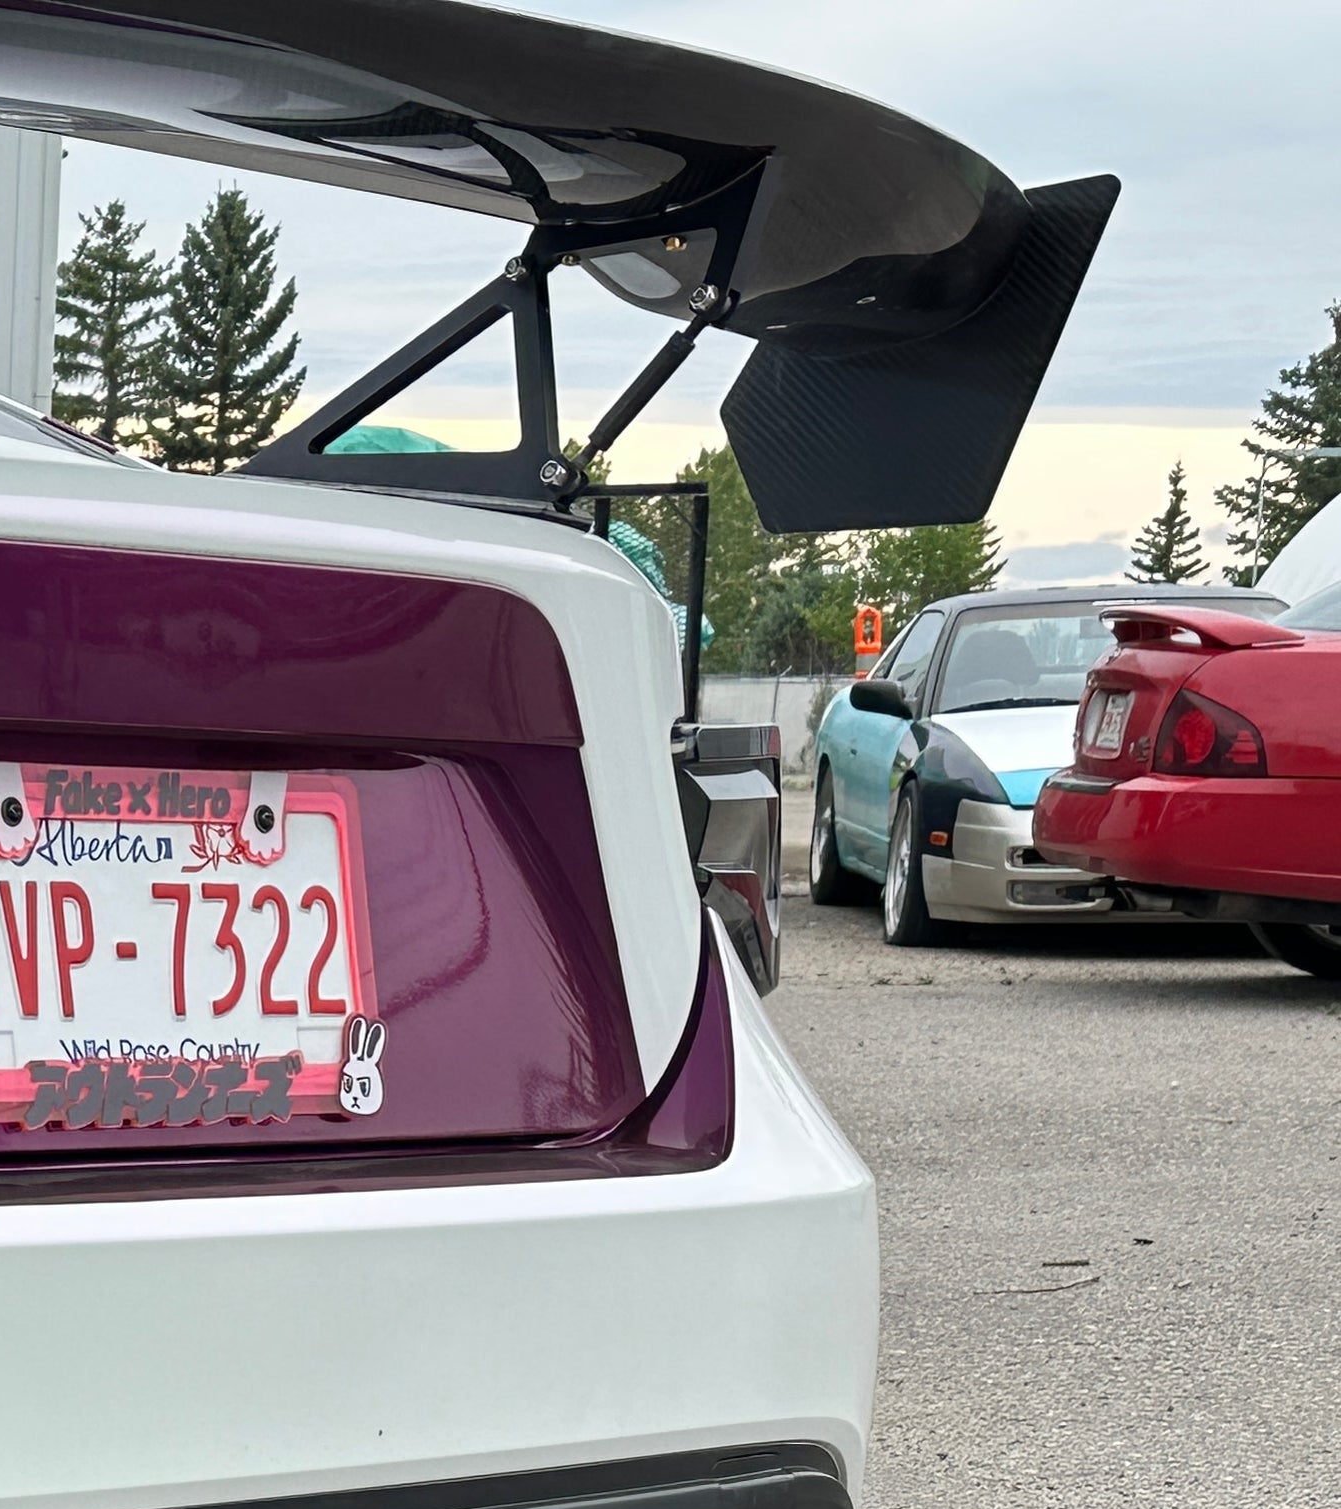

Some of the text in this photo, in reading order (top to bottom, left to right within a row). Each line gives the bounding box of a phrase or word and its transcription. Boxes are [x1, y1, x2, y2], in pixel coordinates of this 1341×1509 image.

[44, 769, 122, 815] Fake
[156, 772, 231, 818] Hero
[14, 819, 161, 866] Alberta
[59, 1039, 112, 1064] Wild
[120, 1039, 172, 1064] Rose
